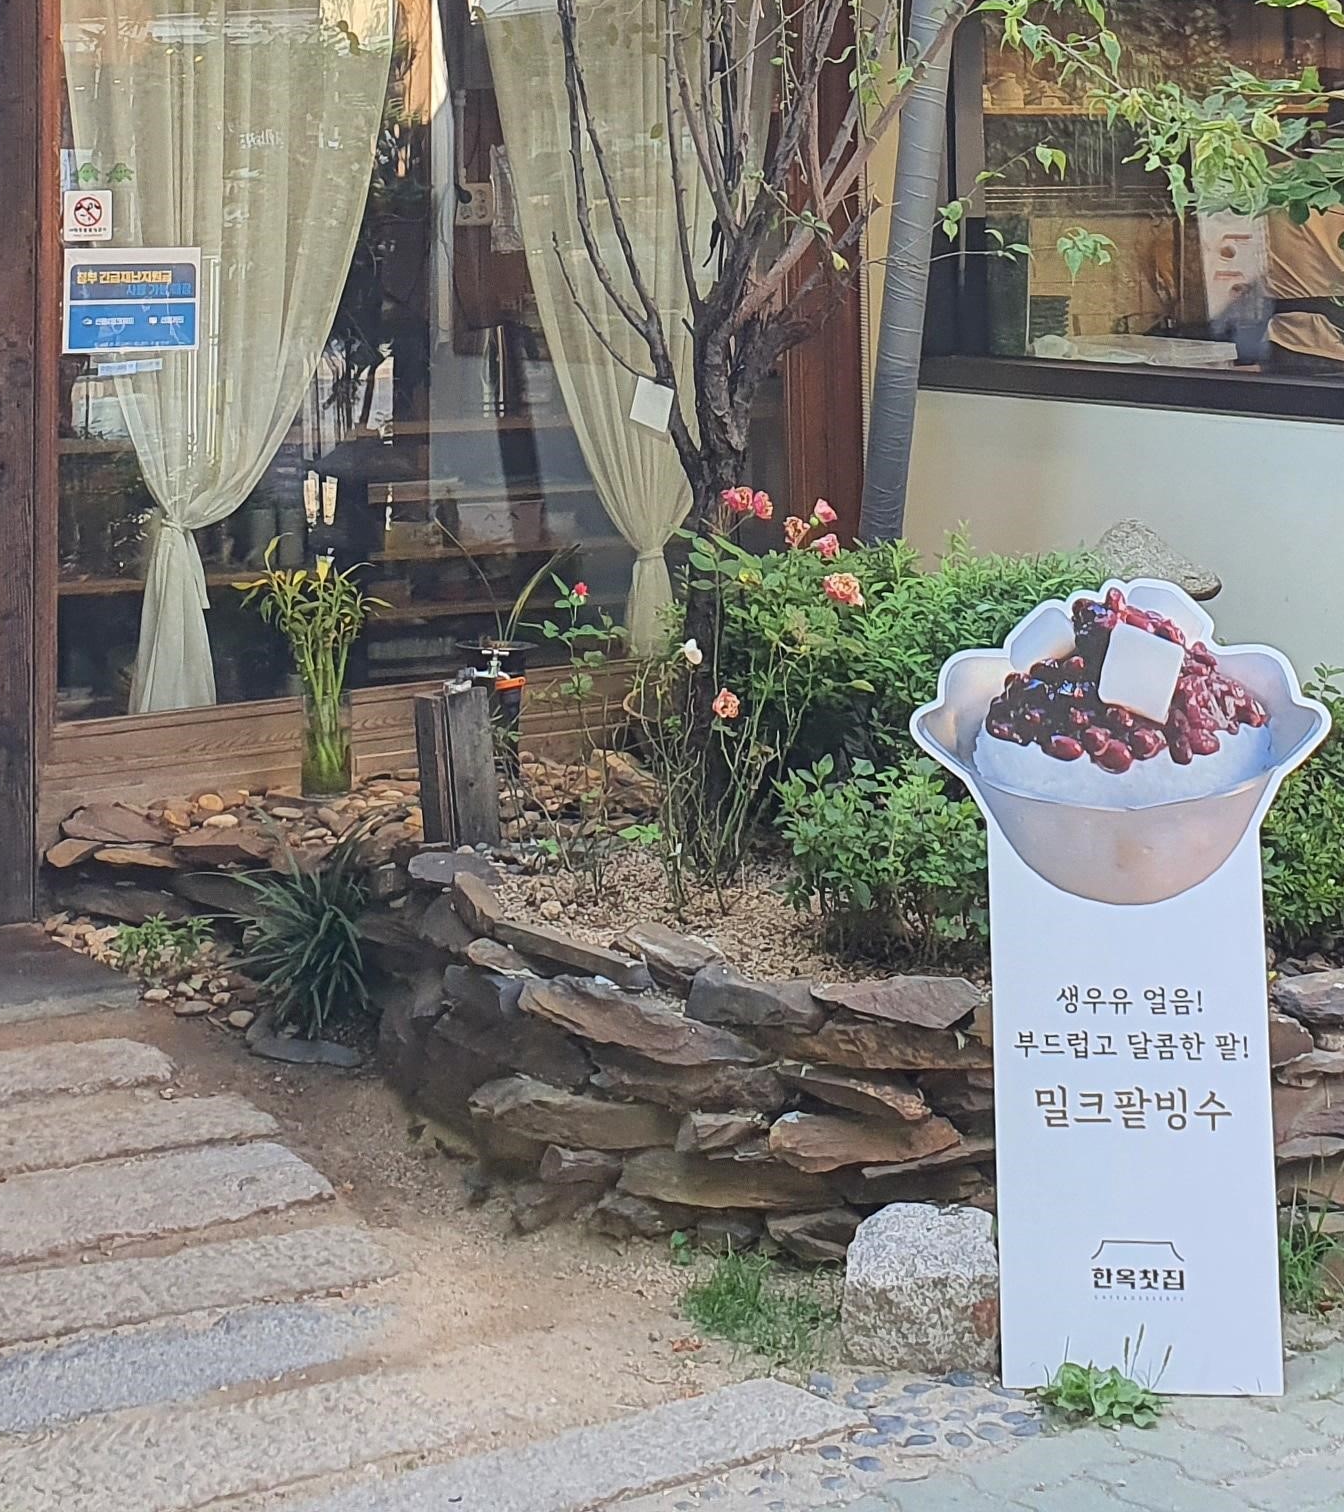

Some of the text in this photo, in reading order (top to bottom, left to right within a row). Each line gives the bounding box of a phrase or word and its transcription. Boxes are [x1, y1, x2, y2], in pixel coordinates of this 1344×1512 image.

[1056, 984, 1203, 1016] 생우유 얼음!
[1014, 1030, 1249, 1061] 부드럽고 달콤한 팥!
[1035, 1085, 1233, 1132] 밀크팥빙수
[1091, 1267, 1185, 1291] 한옥찻집
